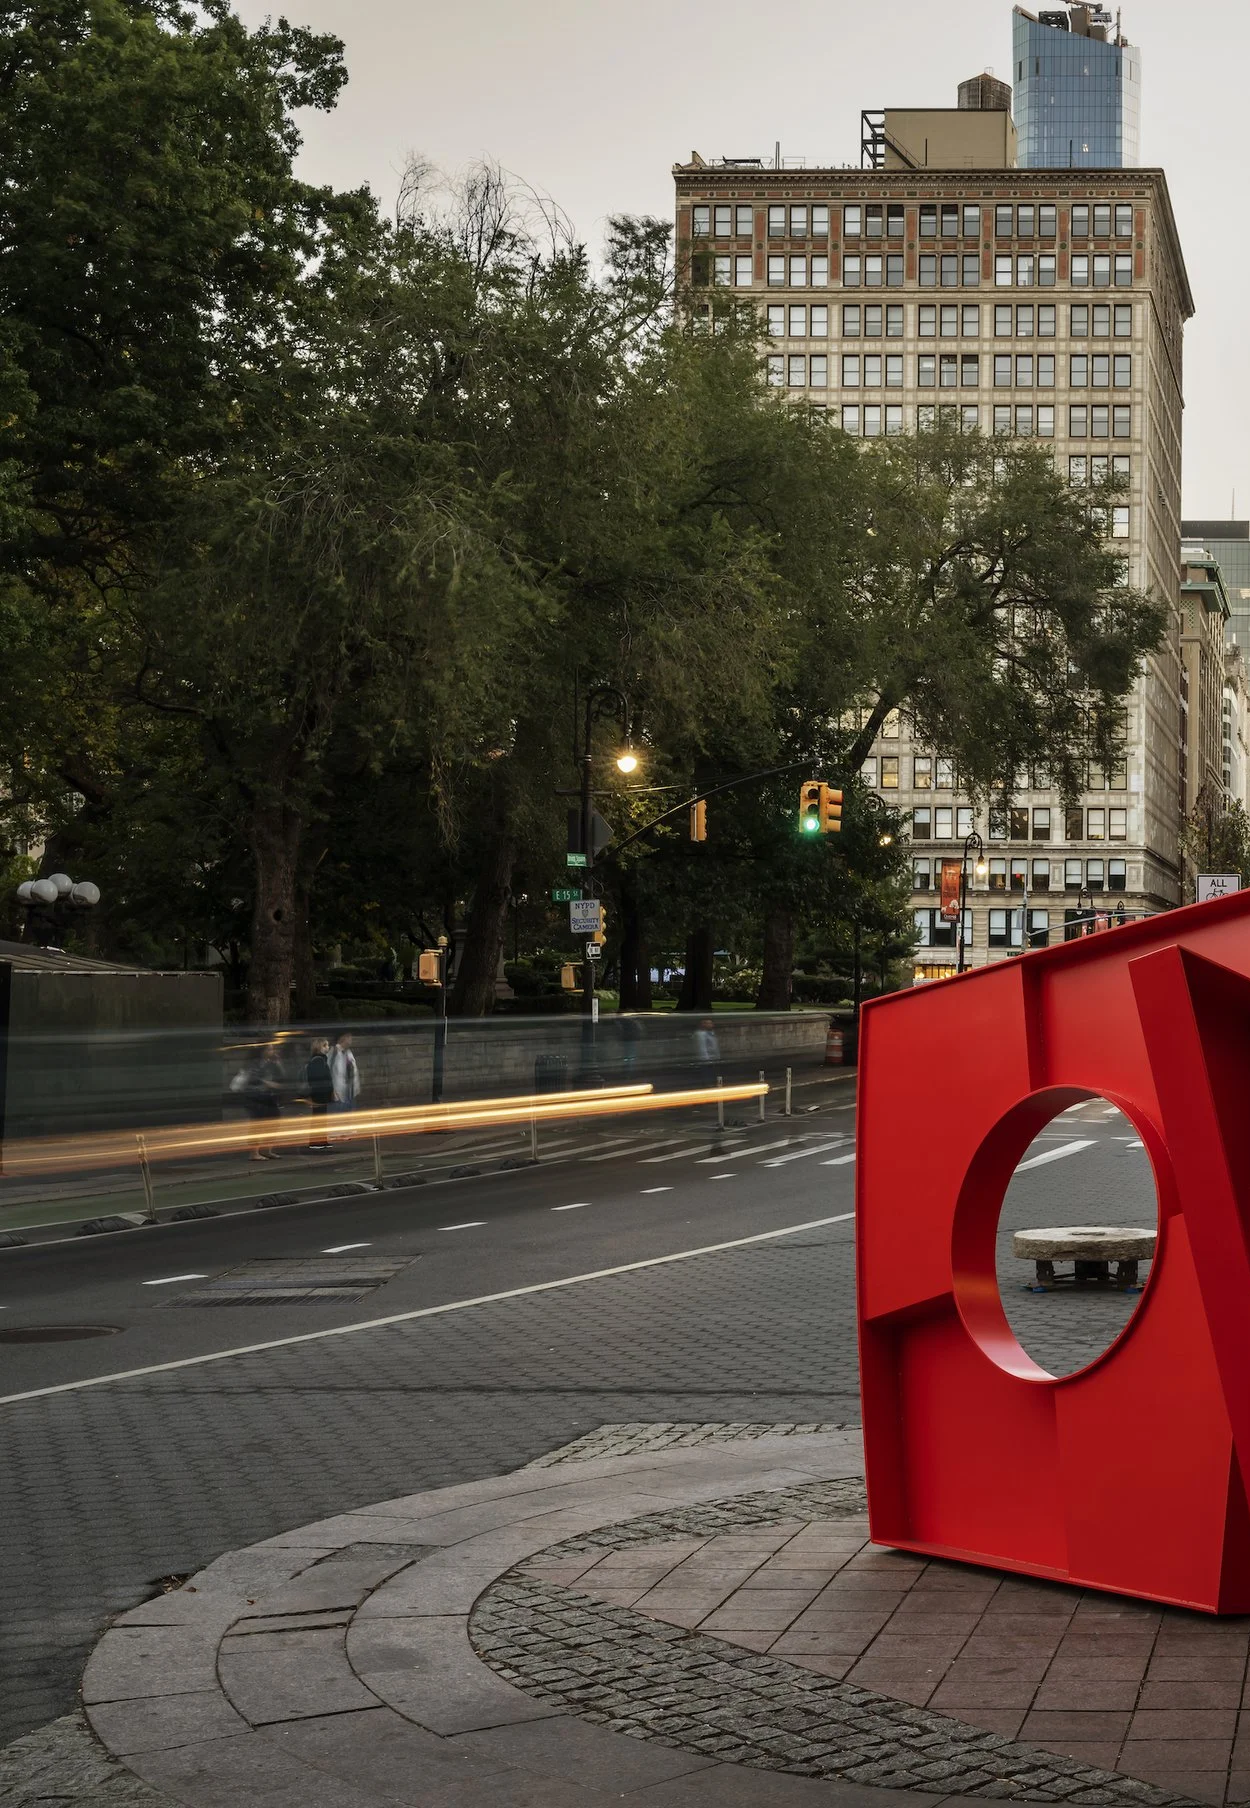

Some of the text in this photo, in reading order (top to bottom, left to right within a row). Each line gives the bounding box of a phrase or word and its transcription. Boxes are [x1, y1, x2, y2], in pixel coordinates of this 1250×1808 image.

[1210, 878, 1227, 888] ALL
[556, 890, 560, 900] E
[562, 890, 571, 900] 15
